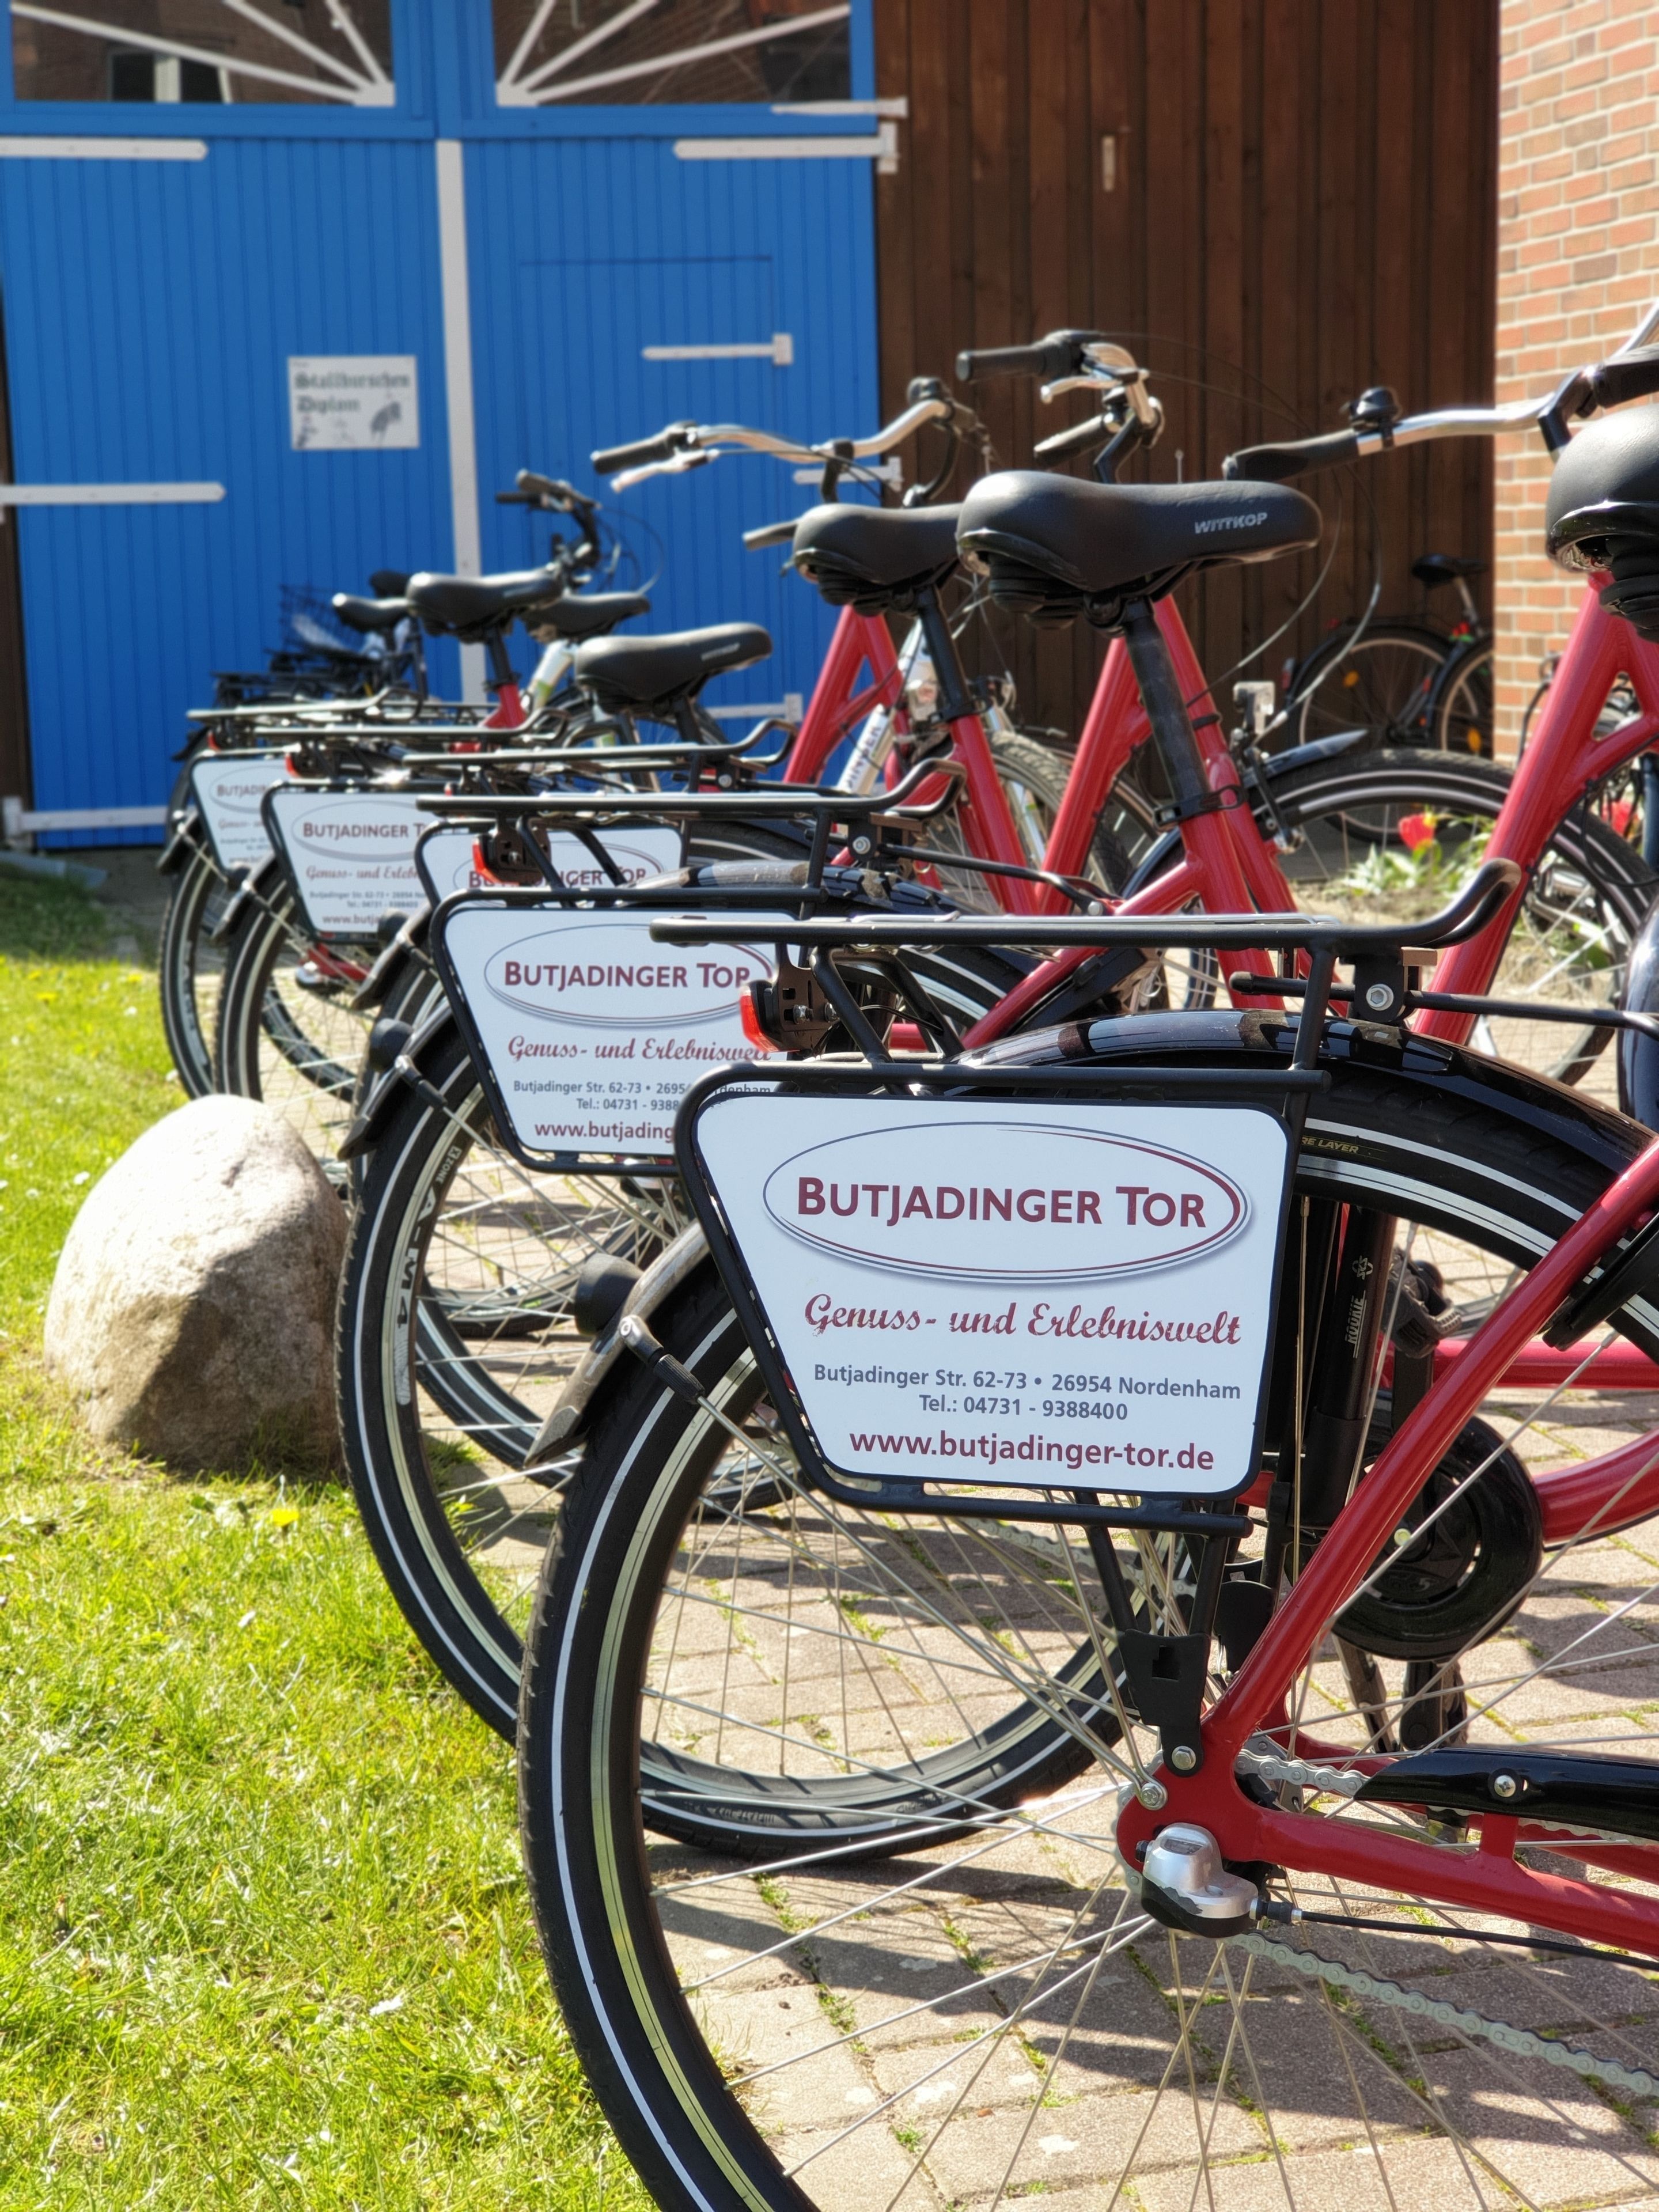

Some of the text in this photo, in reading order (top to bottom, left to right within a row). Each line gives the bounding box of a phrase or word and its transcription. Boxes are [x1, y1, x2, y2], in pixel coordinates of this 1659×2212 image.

[1194, 512, 1267, 534] WITTKOP
[303, 822, 408, 840] BUTJADINGER
[505, 961, 688, 991] BUTJADINGER
[508, 1036, 587, 1061] Genuss-
[595, 1038, 636, 1059] und
[514, 1081, 582, 1096] Butjadinger
[586, 1081, 605, 1093] Str.
[609, 1082, 642, 1094] 62-73
[576, 1098, 599, 1110] Tel.:
[603, 1099, 638, 1111] 04731
[650, 1099, 679, 1111] 9388
[535, 1120, 674, 1143] www.butjading
[1318, 1139, 1359, 1154] LAYER
[797, 1177, 1206, 1228] BUTJADINGER TOR
[805, 1294, 1241, 1345] Genuss- und Erlebniswelt
[1344, 1294, 1365, 1345] ROOKIE
[815, 1363, 1240, 1399] Butjadinger Str. 62-73 26954 Nordenham
[919, 1394, 957, 1412] Tel.:
[964, 1396, 1020, 1415] 04731
[1043, 1400, 1128, 1420] 9388400
[849, 1430, 1214, 1471] www.butjadinger-tor.de
